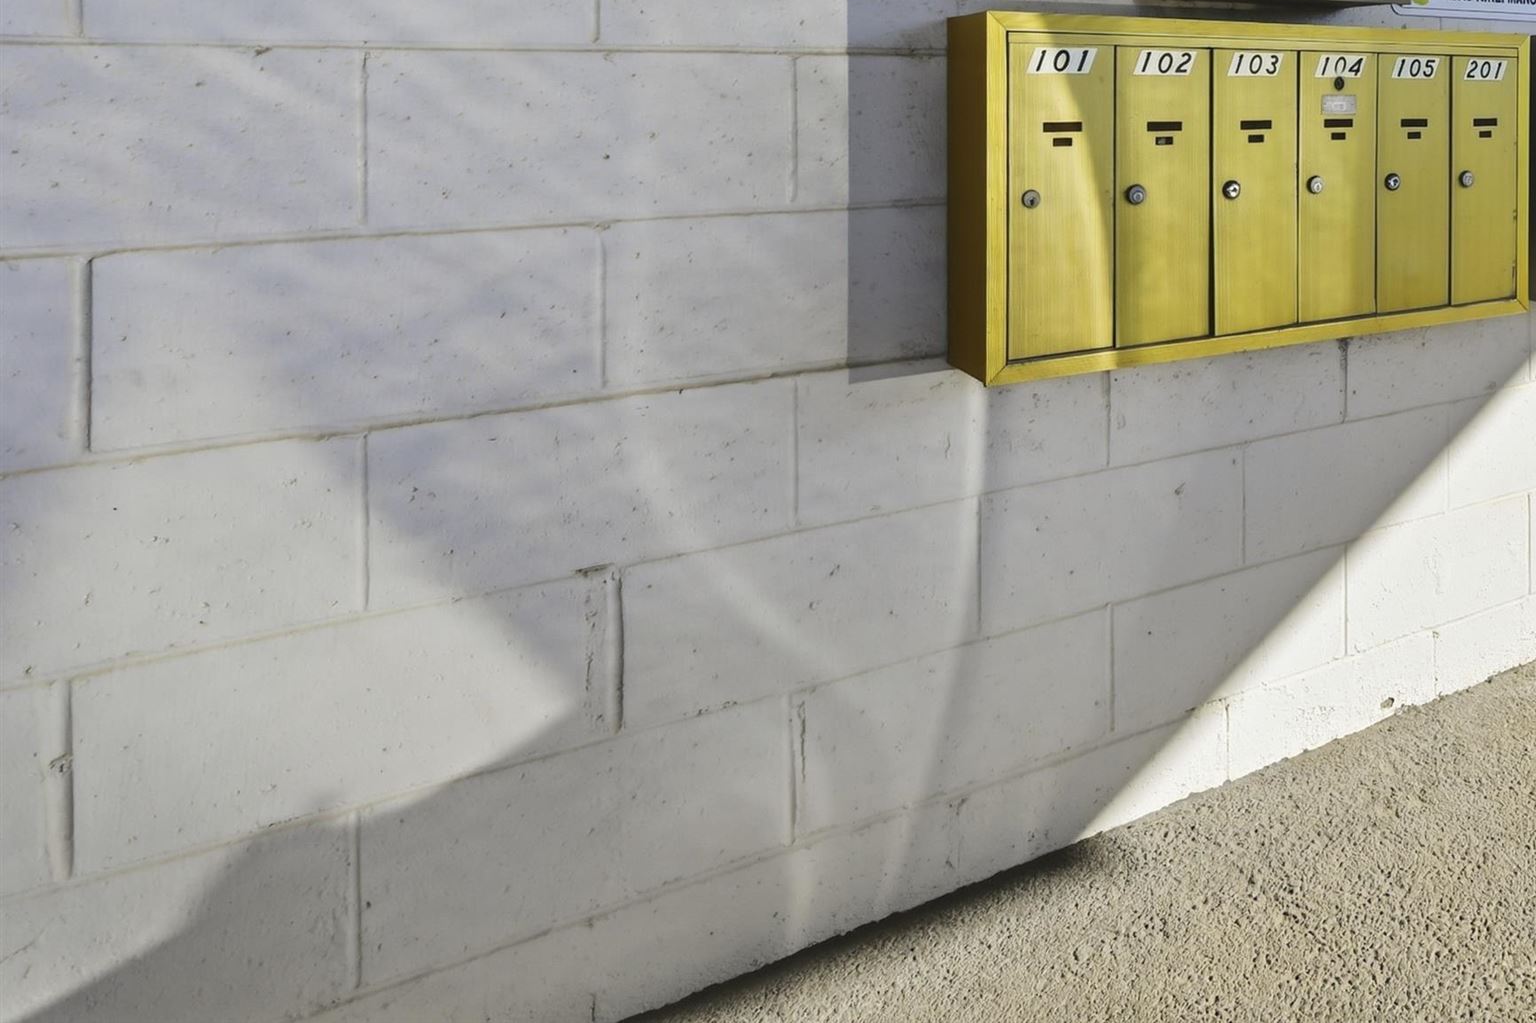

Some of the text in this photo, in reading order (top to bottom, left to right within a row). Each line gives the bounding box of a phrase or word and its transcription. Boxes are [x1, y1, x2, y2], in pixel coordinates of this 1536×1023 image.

[1036, 49, 1089, 72] 101
[1141, 51, 1192, 74] 102
[1235, 54, 1279, 75] 103
[1321, 56, 1364, 76] 104
[1397, 58, 1435, 78] 105
[1466, 60, 1502, 79] 201
